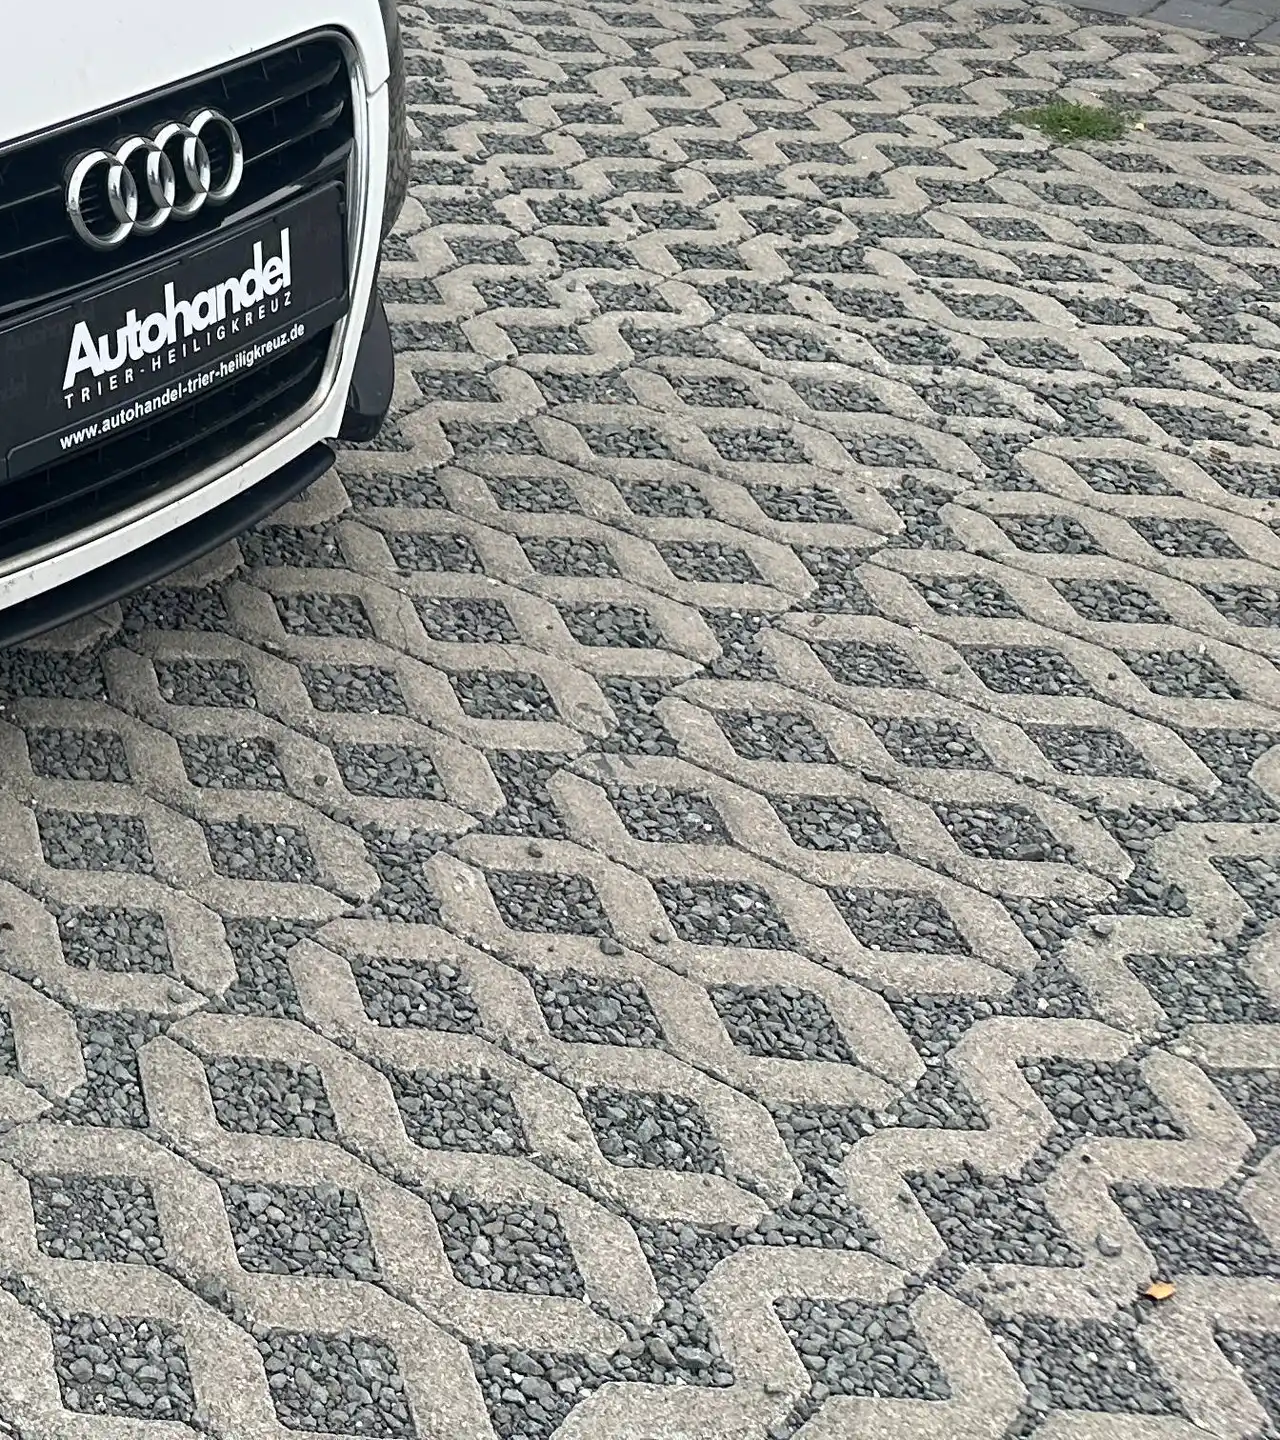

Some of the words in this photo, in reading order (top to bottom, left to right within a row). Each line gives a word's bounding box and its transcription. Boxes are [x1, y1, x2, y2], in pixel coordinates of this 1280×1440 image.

[62, 228, 292, 391] Autohandel
[64, 292, 292, 410] TRIER-HEILIGKREUZ
[59, 323, 305, 450] www.autohandel-trier-heiligkreuz.de
